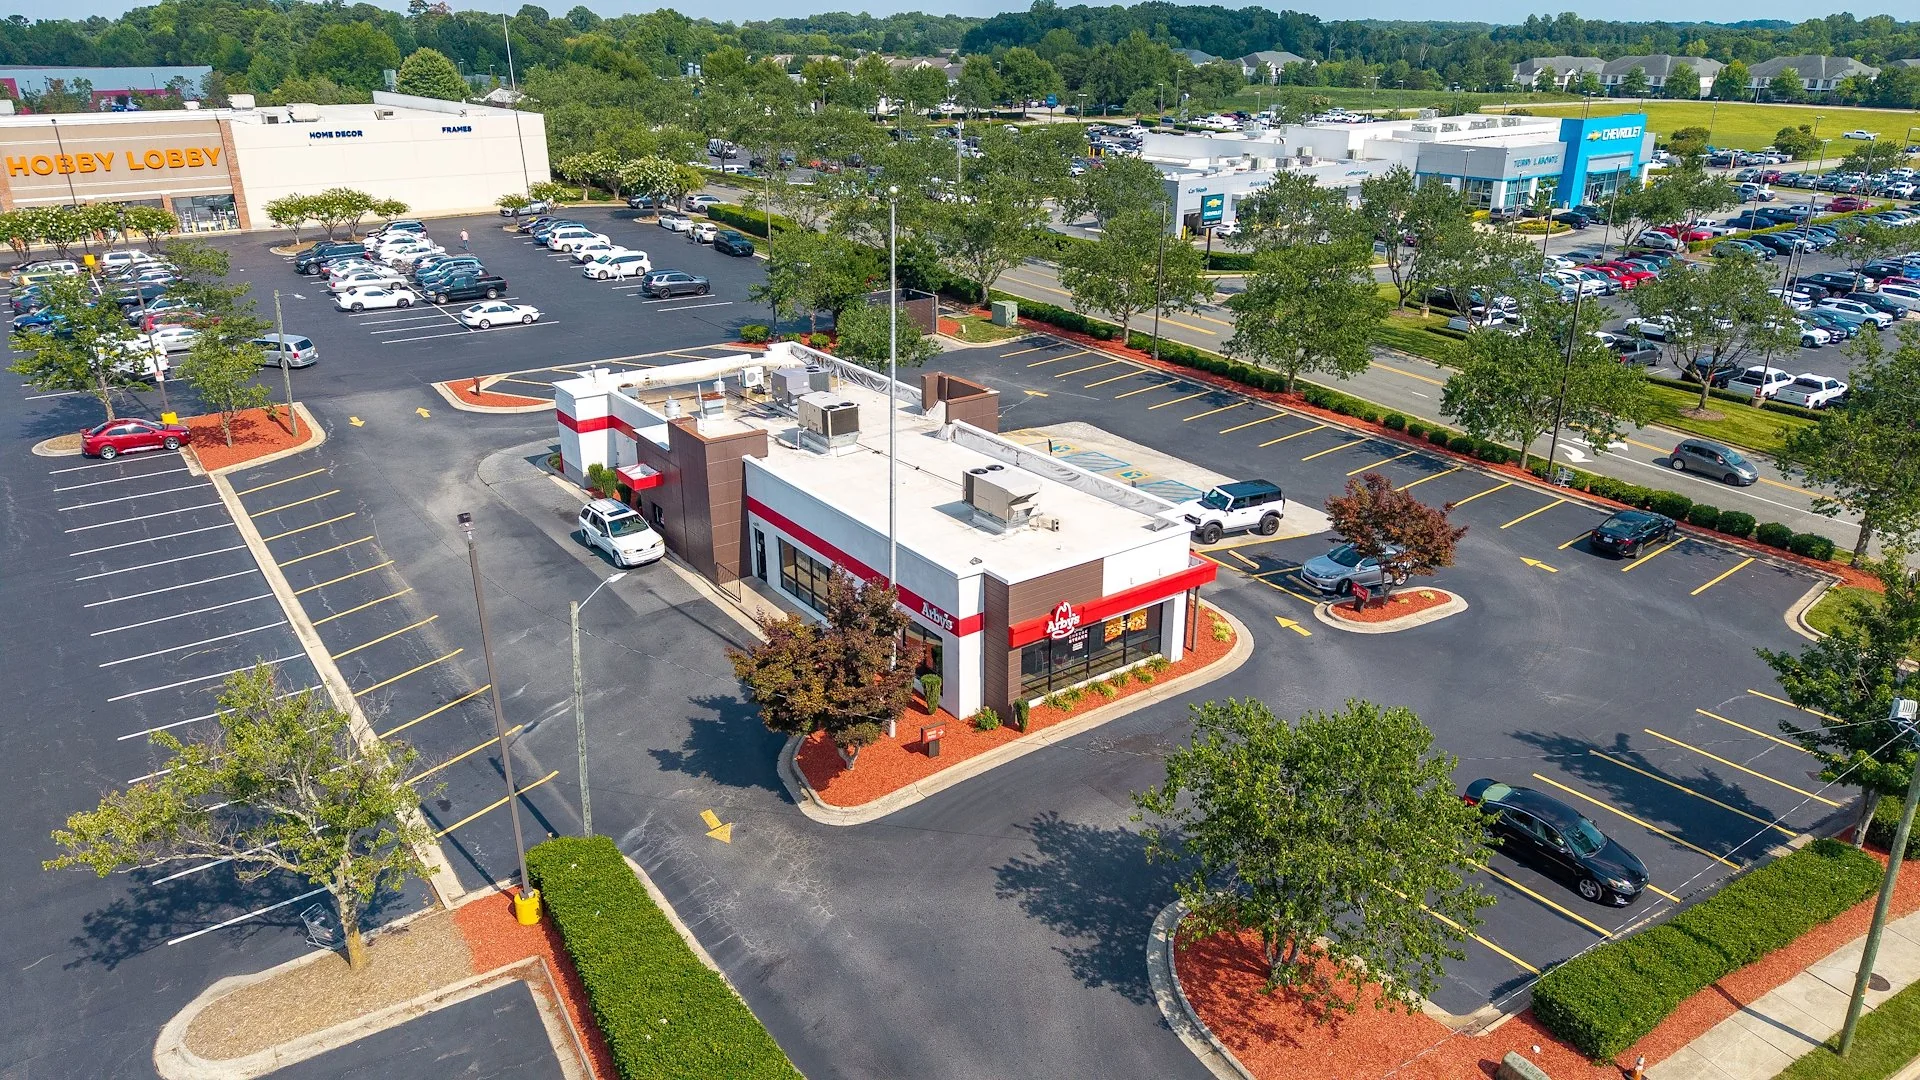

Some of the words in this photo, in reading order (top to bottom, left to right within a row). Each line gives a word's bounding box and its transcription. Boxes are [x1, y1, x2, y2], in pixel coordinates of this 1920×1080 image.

[309, 131, 333, 139] HOME
[335, 130, 363, 138] DECOR
[441, 125, 472, 133] FRAMES
[1602, 126, 1642, 141] CHEVROLET
[6, 152, 114, 176] HOBBY
[126, 147, 221, 170] LOBBY
[921, 601, 953, 631] Arby's
[1046, 613, 1080, 634] Arby's
